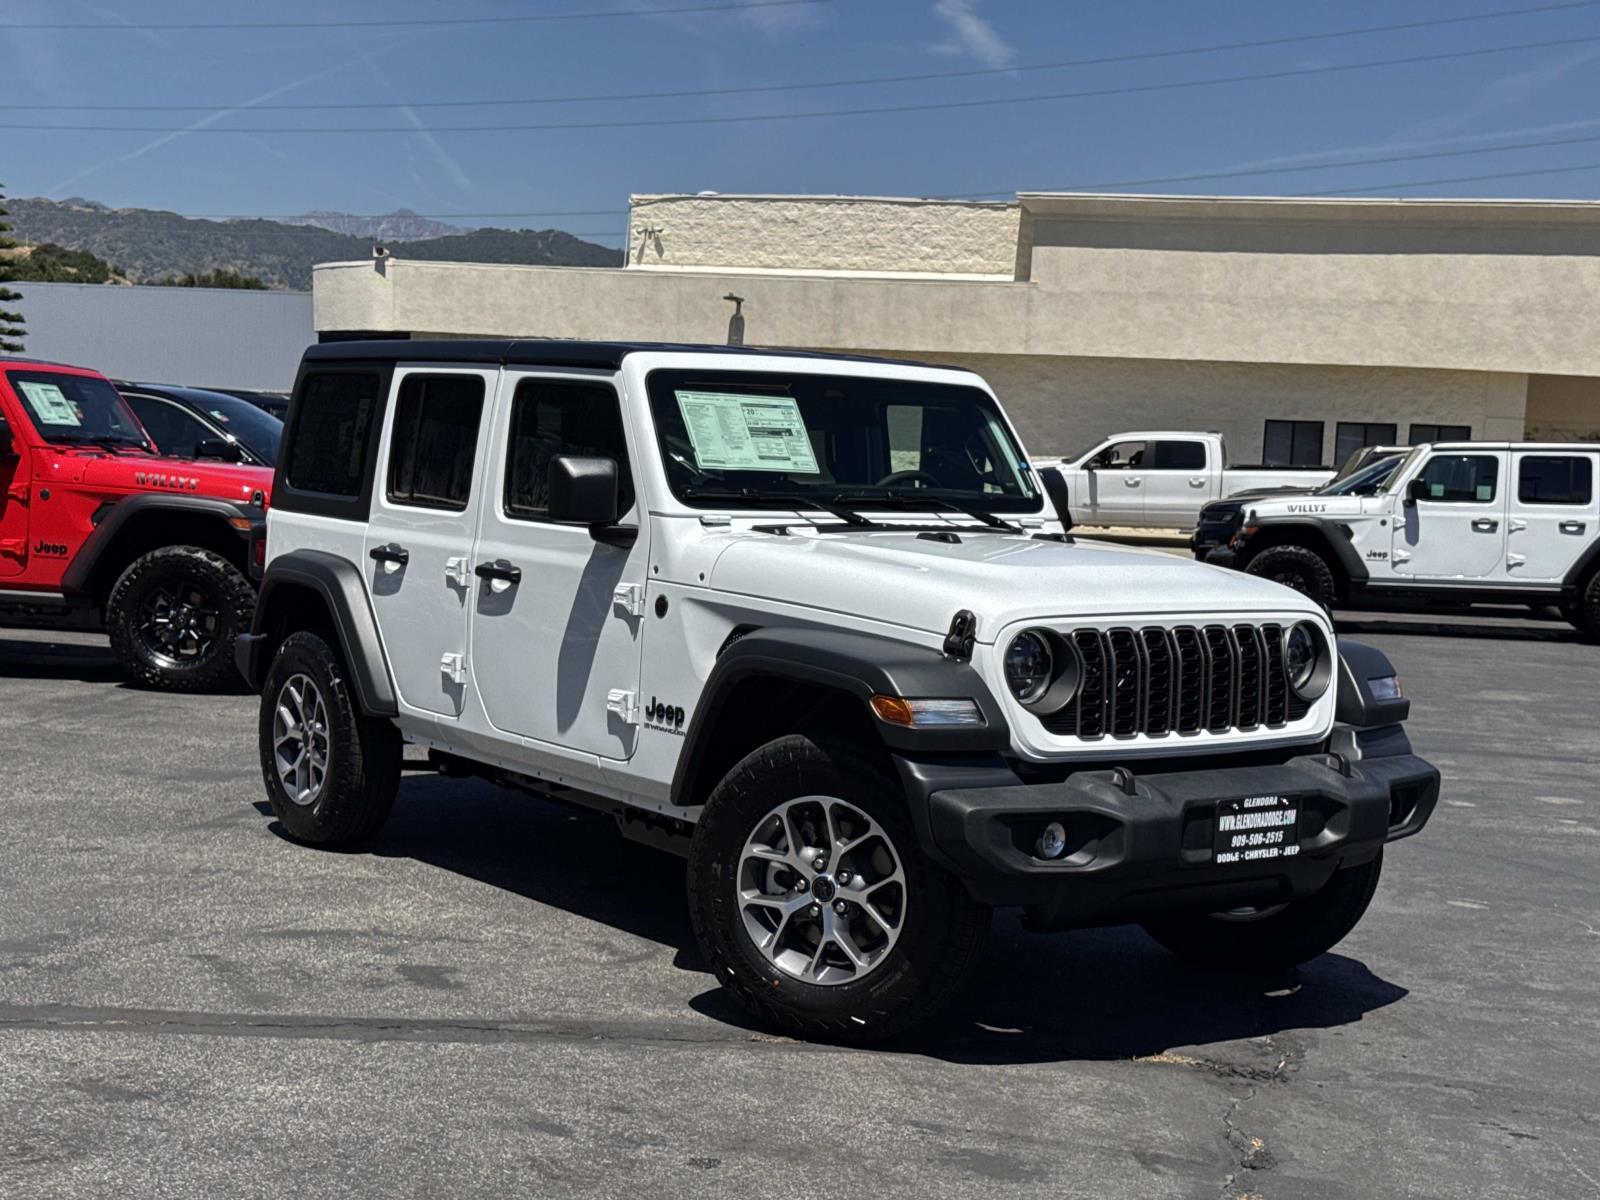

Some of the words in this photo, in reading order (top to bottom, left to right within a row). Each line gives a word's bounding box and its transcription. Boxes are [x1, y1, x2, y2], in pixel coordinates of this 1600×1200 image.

[135, 471, 200, 490] WILLYS
[1287, 504, 1327, 513] WILLYS
[33, 541, 68, 556] Jeep
[1366, 550, 1388, 559] Jeep
[645, 696, 685, 728] Jeep
[1244, 796, 1278, 808] GLENDORA
[1231, 831, 1284, 847] 909-506-2515
[1217, 852, 1239, 863] DODGE
[1245, 848, 1278, 860] CHRYSLER
[1283, 845, 1300, 856] JEEP
